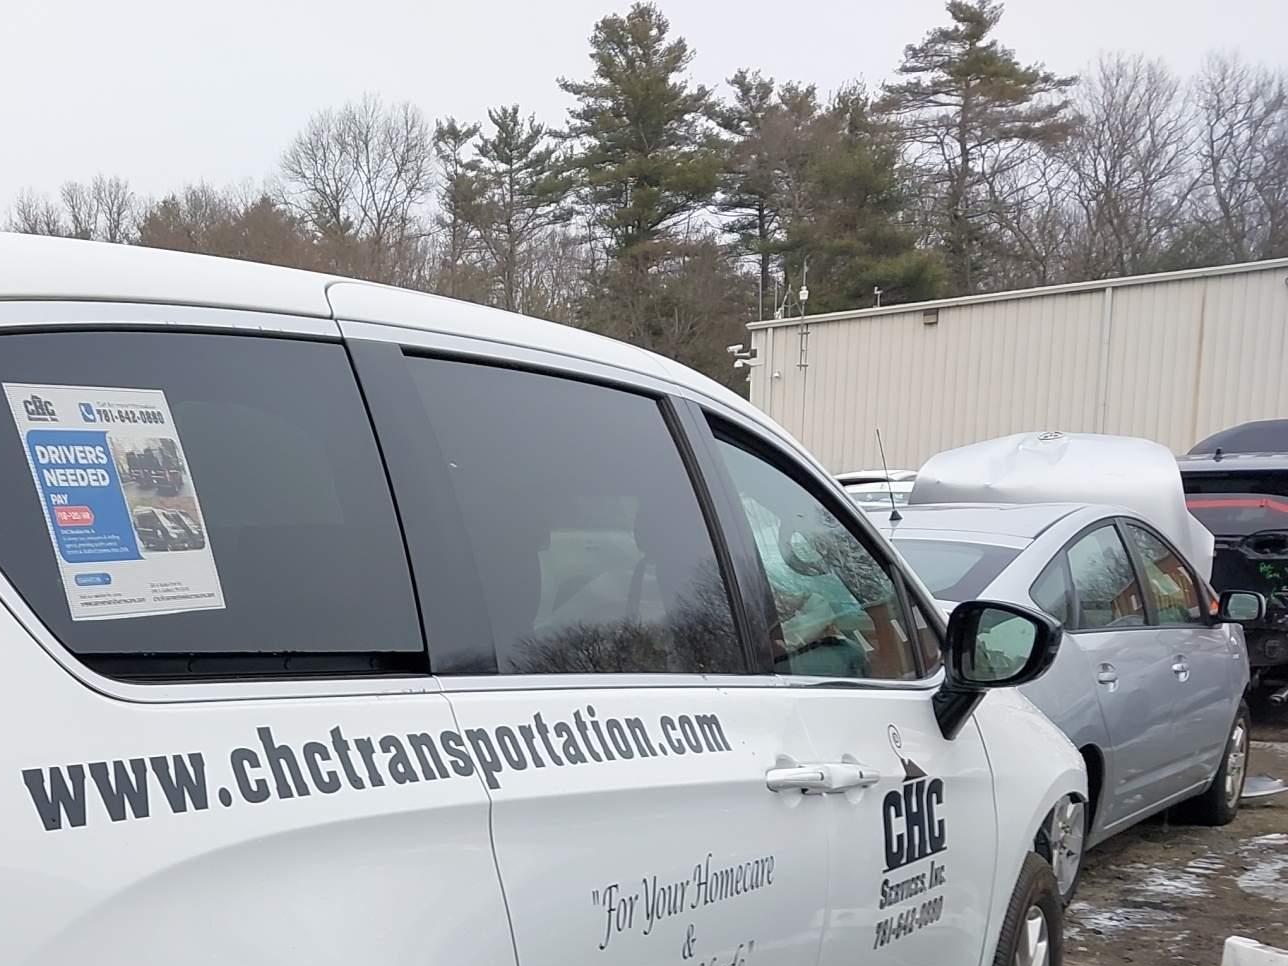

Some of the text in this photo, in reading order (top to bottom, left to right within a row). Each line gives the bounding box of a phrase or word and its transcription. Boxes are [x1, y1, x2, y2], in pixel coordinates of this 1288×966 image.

[22, 399, 56, 417] CHC
[35, 445, 108, 465] DRIVERS
[43, 469, 110, 487] NEEDED
[50, 494, 69, 505] PAY
[22, 704, 732, 832] www.chctransportation.com
[882, 778, 946, 869] CHC
[642, 875, 690, 936] Your
[690, 853, 775, 910] Homecare
[682, 924, 697, 960] &
